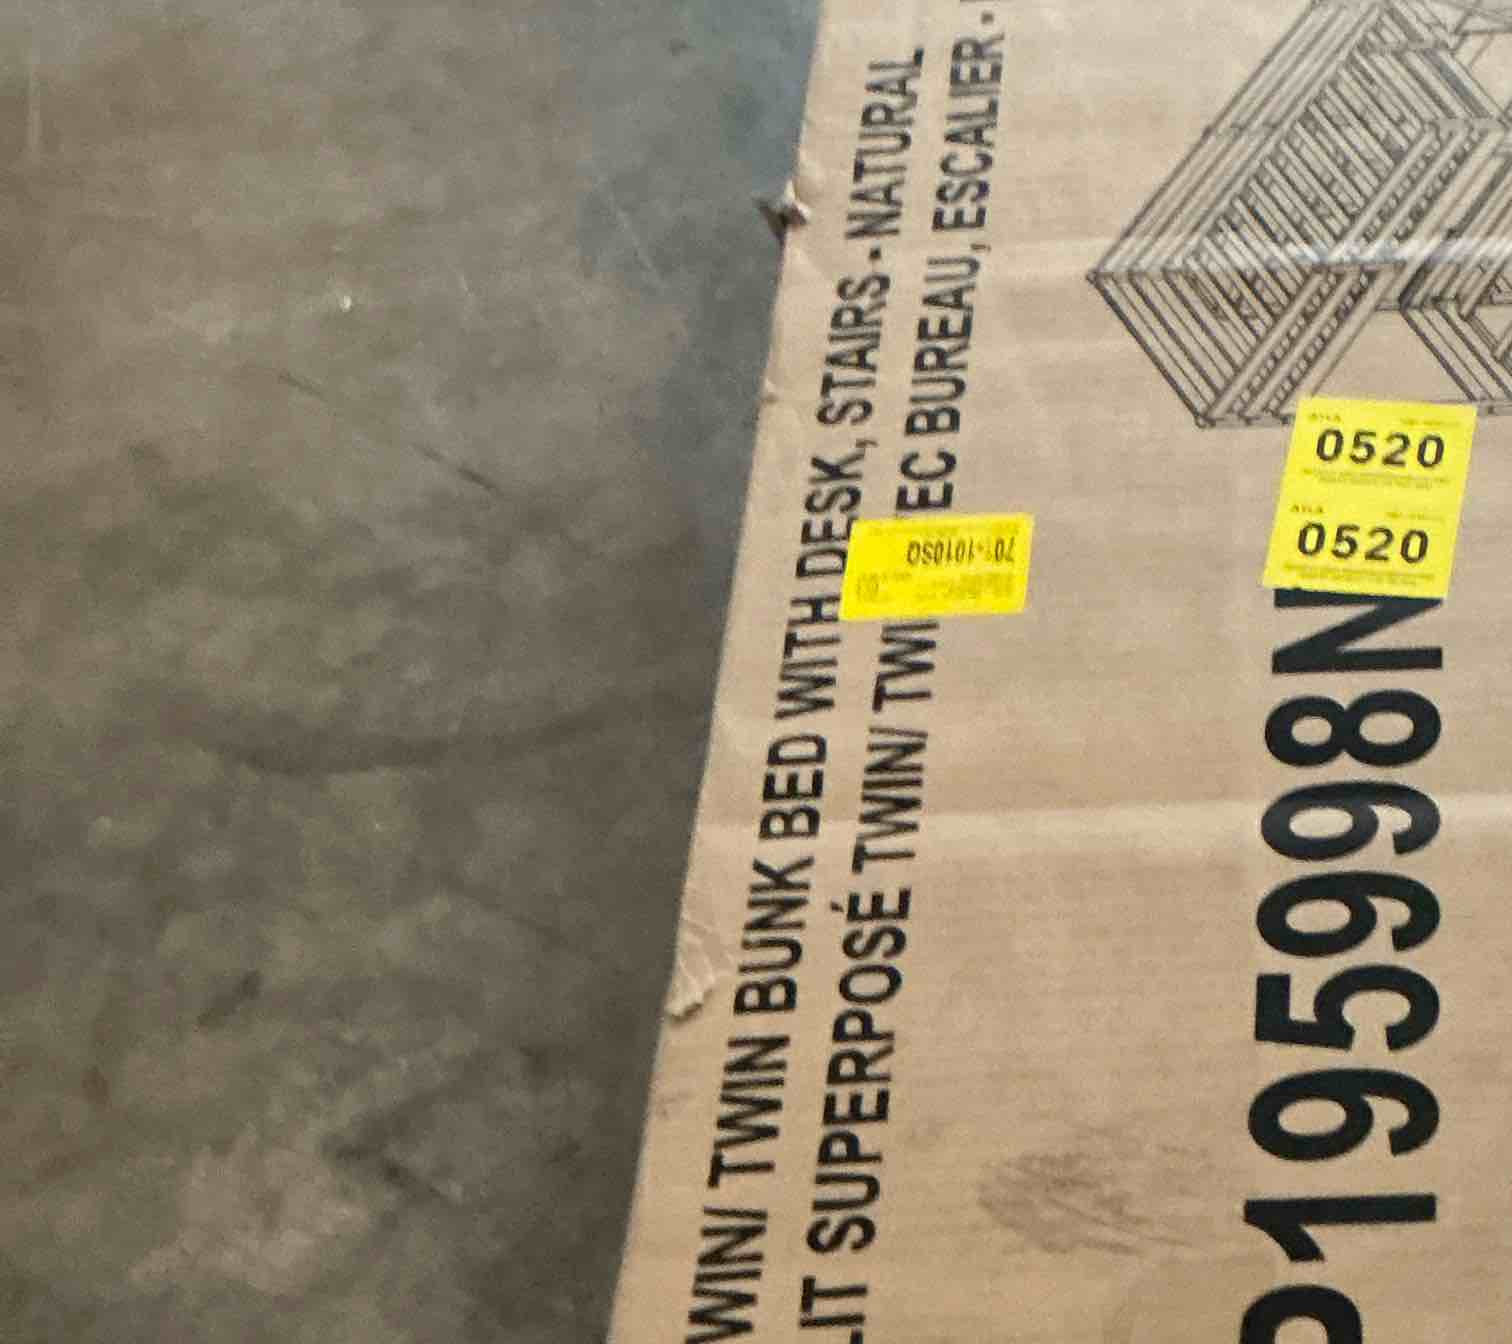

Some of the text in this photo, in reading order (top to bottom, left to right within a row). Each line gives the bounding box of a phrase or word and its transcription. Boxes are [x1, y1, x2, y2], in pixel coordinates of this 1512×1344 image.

[844, 49, 925, 239] NATURAL
[932, 33, 1006, 230] ESCALIER
[816, 274, 891, 425] STAIRS
[904, 243, 990, 434] BUREAU,
[795, 438, 877, 578] DESK,
[1316, 428, 1444, 468] 0520
[1298, 522, 1429, 564] 0520
[774, 596, 841, 719] WITH
[871, 621, 939, 713] TWI
[759, 734, 828, 838] BED
[850, 726, 928, 874] TWIN/
[732, 857, 811, 1013] BUNK
[707, 1035, 791, 1188] TWIN
[806, 888, 911, 1254] SUPERPOSÉ
